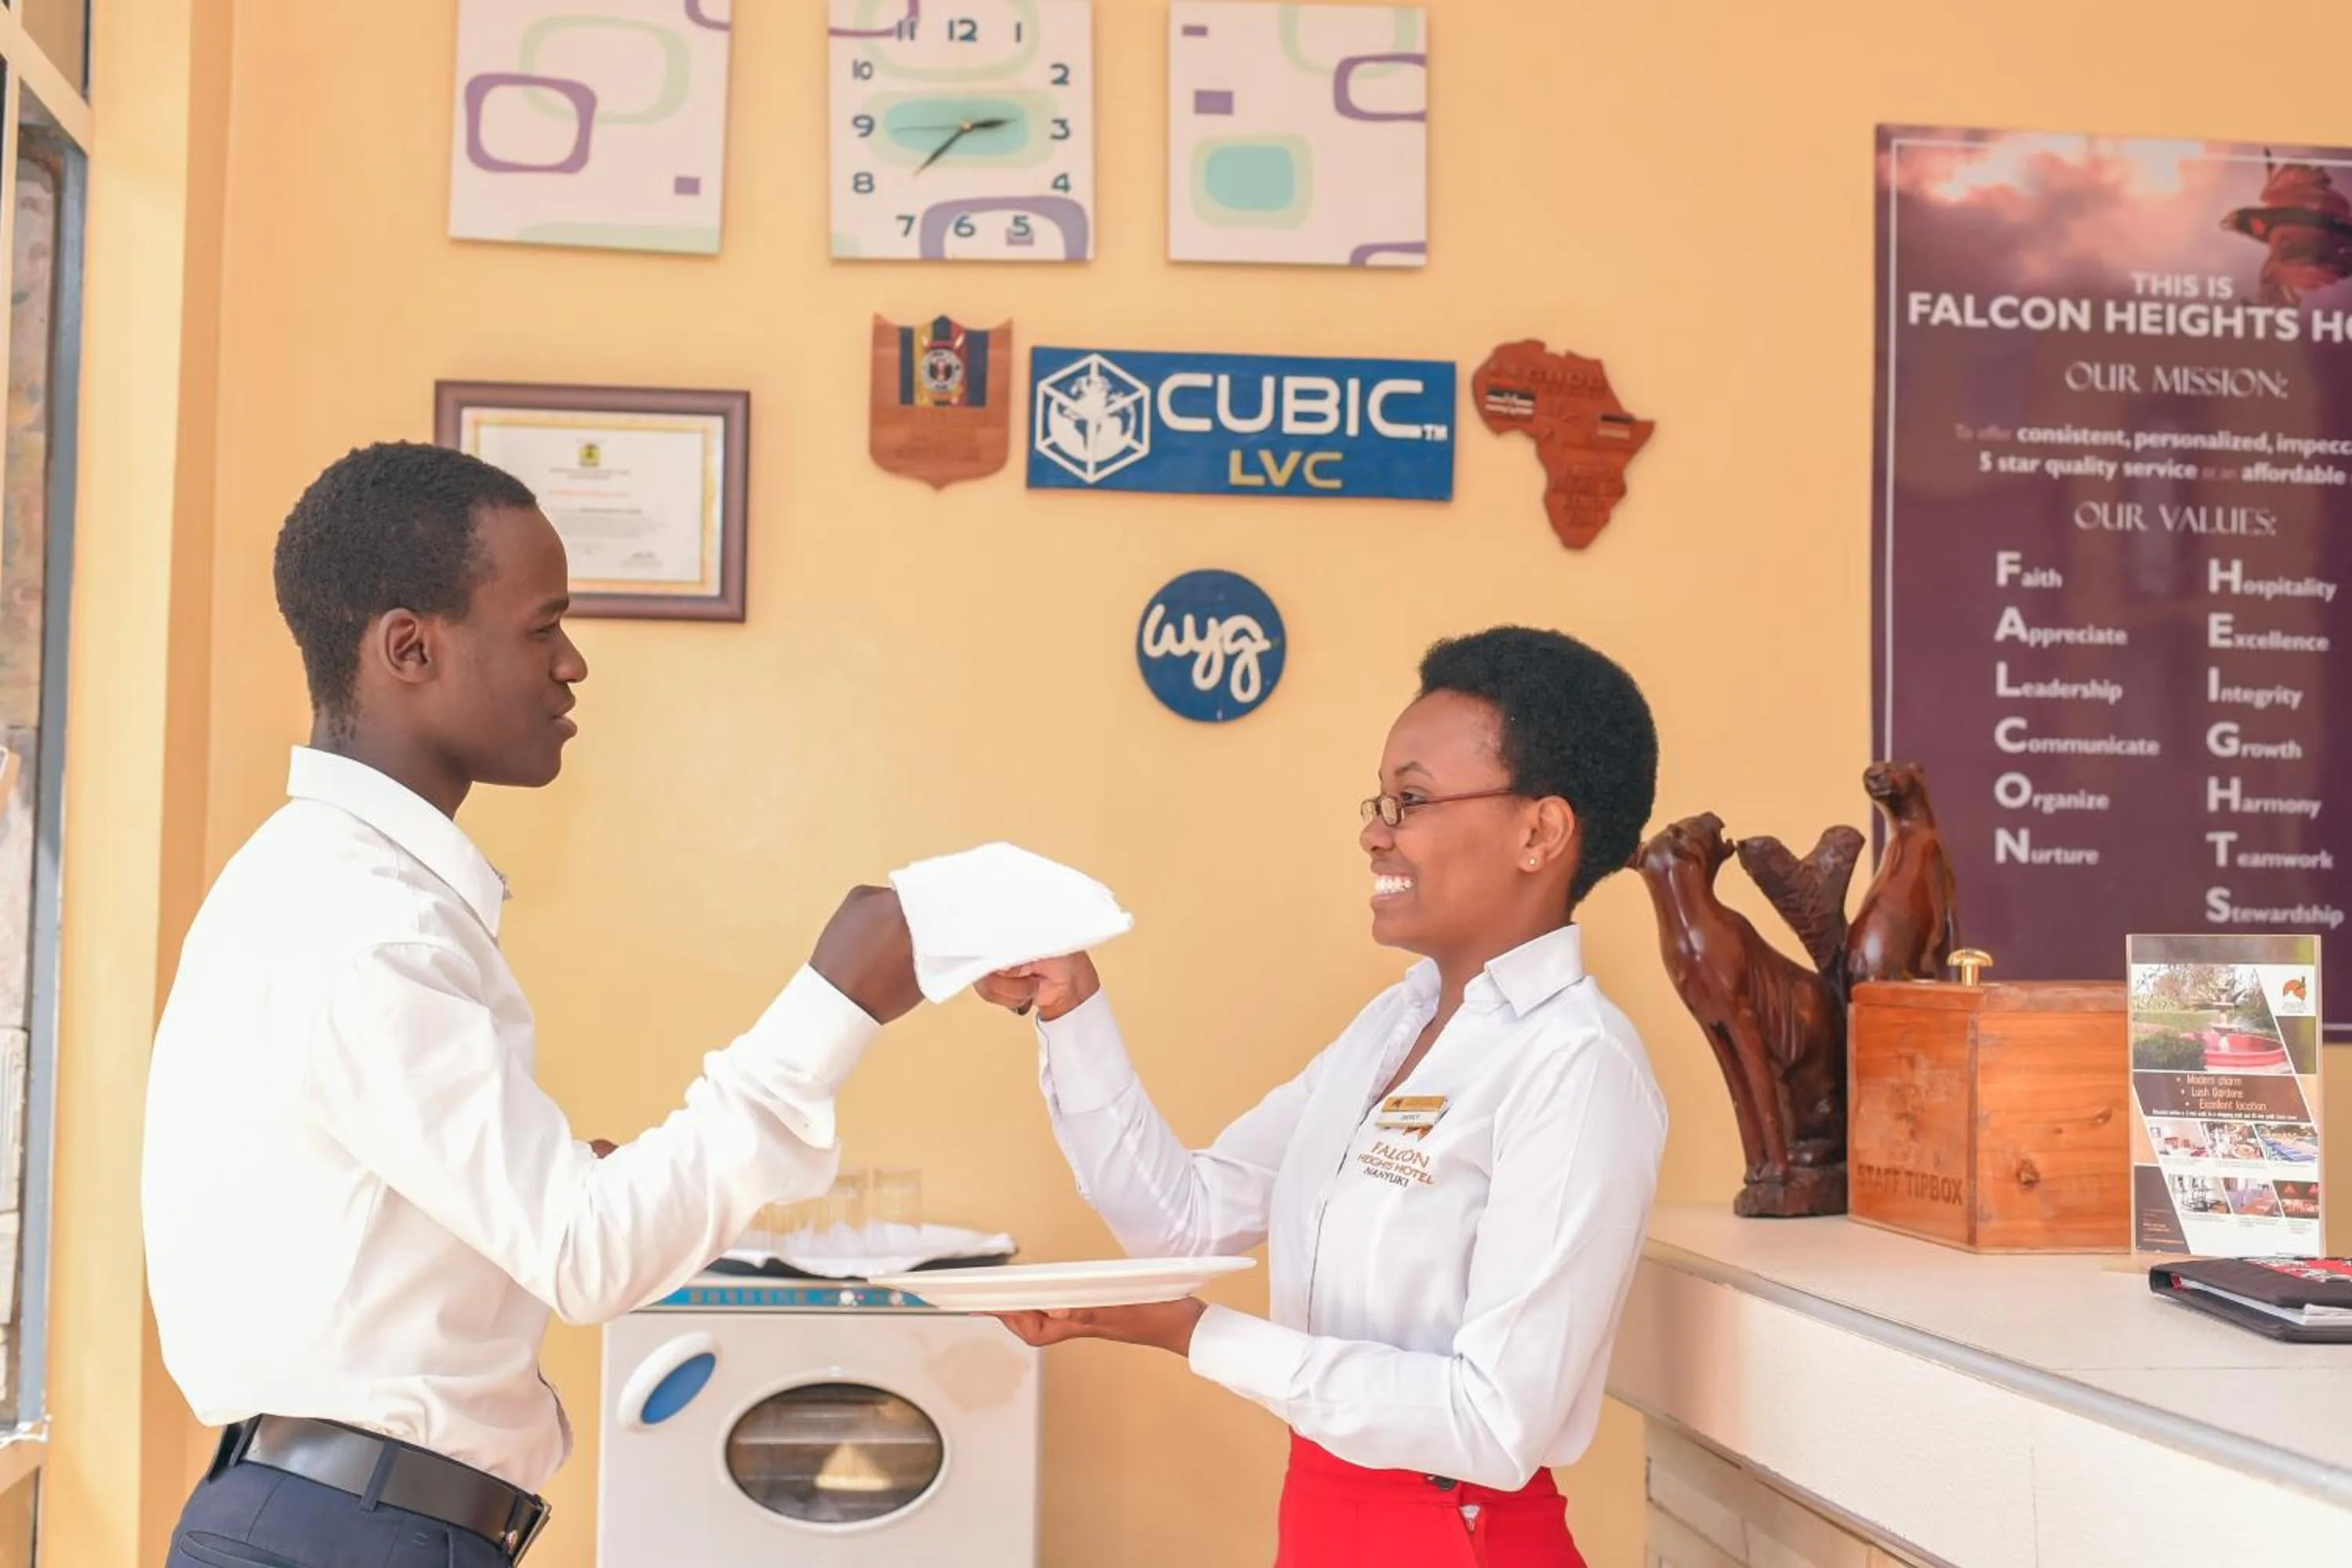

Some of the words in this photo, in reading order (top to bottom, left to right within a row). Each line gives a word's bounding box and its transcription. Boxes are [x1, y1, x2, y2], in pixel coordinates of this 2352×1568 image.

[895, 20, 916, 41] 11
[947, 18, 978, 42] 12
[1014, 21, 1022, 42] 1
[851, 60, 874, 81] 10
[1050, 63, 1070, 85] 2
[851, 114, 875, 137] 9
[1050, 118, 1071, 141] 3
[851, 172, 876, 194] 8
[1051, 172, 1071, 194] 4
[895, 215, 916, 237] 7
[953, 215, 976, 238] 6
[1012, 216, 1029, 238] 5
[2130, 272, 2198, 299] THIS
[2209, 276, 2233, 299] IS
[1908, 292, 2091, 332] FALCON
[2105, 301, 2300, 342] HEIGHTS
[2311, 309, 2352, 343] H
[2064, 361, 2140, 392] OUR
[2152, 365, 2288, 399] MISSION:
[1156, 372, 1424, 438] CUBIC
[2016, 424, 2131, 449] consistent,
[2133, 430, 2273, 455] personalized,
[1229, 449, 1343, 489] LVC
[1979, 450, 1992, 473] 5
[1997, 455, 2041, 474] star
[2045, 455, 2118, 482] quality
[2122, 458, 2198, 480] service
[2241, 461, 2347, 485] affordable
[2074, 501, 2148, 532] OUR
[1996, 551, 2063, 588] Faith
[2208, 557, 2337, 602] Hospitality
[1994, 606, 2128, 648] Appreciate
[2208, 612, 2330, 652] Excellence
[1996, 661, 2123, 704] Leadership
[2208, 666, 2303, 709] Integrity
[1994, 717, 2161, 756] Communicate
[2205, 721, 2302, 760] Growth
[1994, 771, 2110, 814] Organize
[2207, 776, 2321, 819] Harmony
[1994, 827, 2100, 865] Nurture
[2205, 831, 2334, 870] Teamwork
[2205, 886, 2344, 929] Stewardship
[2191, 1087, 2210, 1097] Lush
[2199, 1098, 2233, 1110] Excellent
[2235, 1101, 2267, 1111] location
[1370, 1141, 1429, 1168] FALCON
[1363, 1167, 1409, 1187] NANYUKI
[1393, 1163, 1435, 1185] HOTEL
